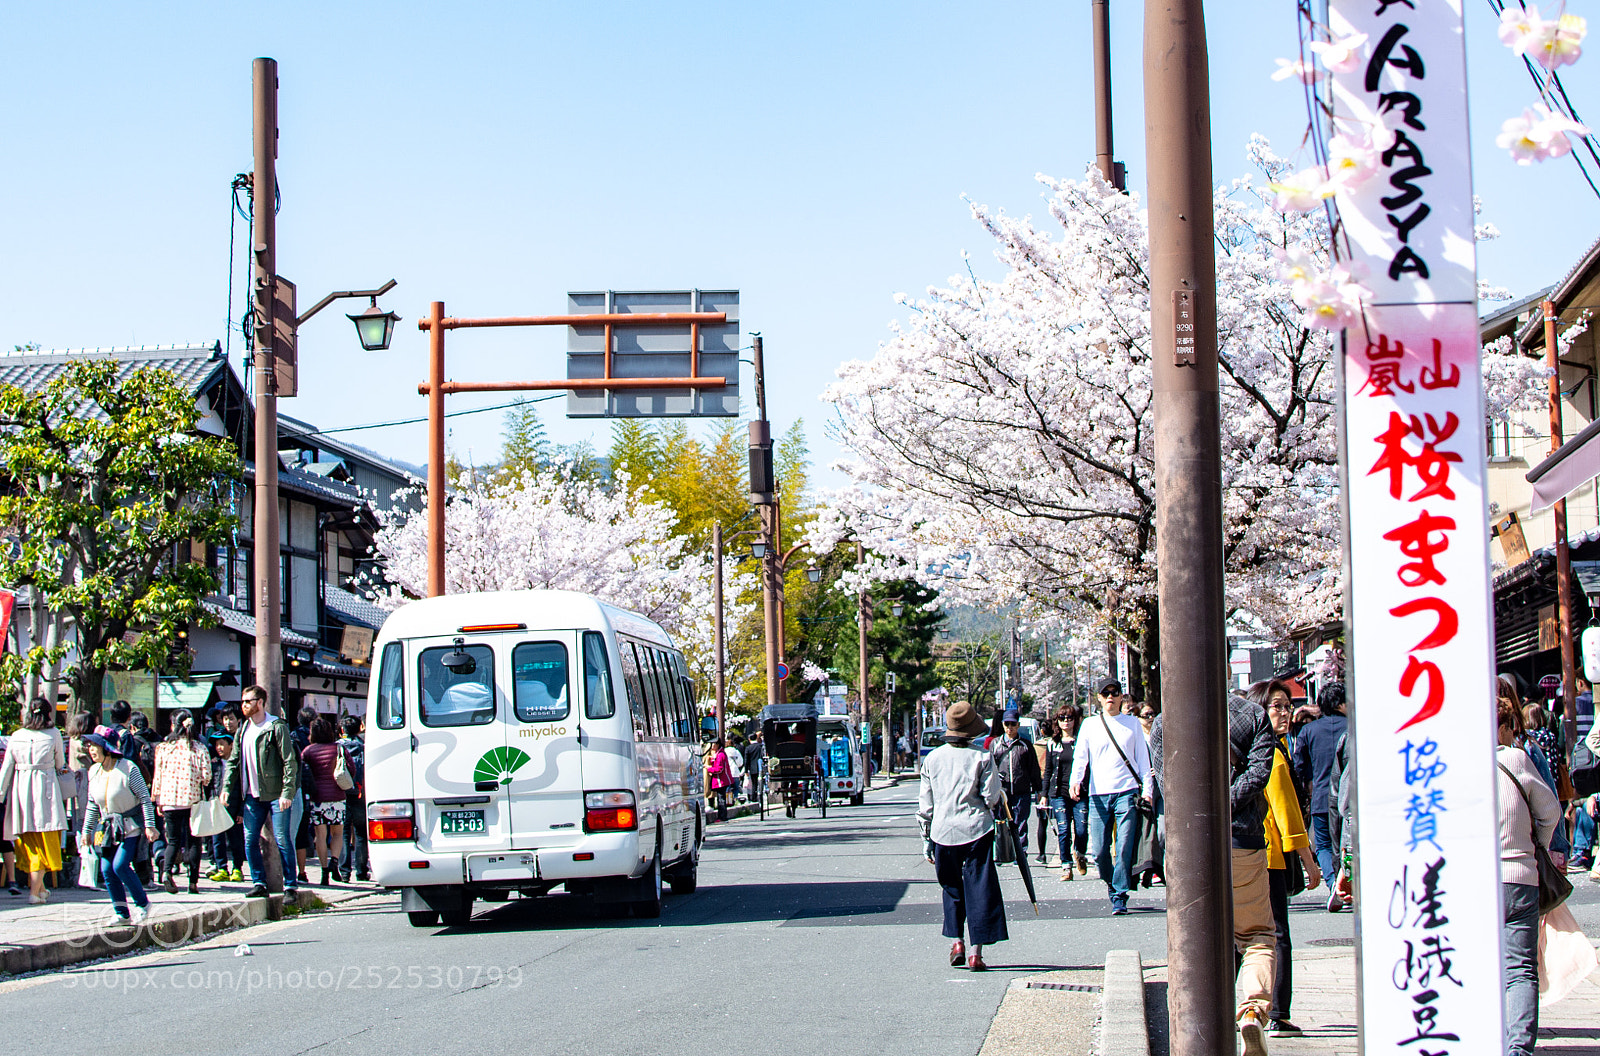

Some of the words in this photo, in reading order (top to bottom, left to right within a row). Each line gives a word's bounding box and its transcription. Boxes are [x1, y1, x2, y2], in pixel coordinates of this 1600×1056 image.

[1176, 323, 1194, 332] 9290
[1354, 334, 1461, 397] 嵐山
[1366, 411, 1463, 734] 桜まつり
[519, 723, 567, 741] miyako
[452, 818, 484, 832] 13-03
[1397, 736, 1448, 853] 協賛
[1388, 856, 1464, 1056] 嵯峨豆
